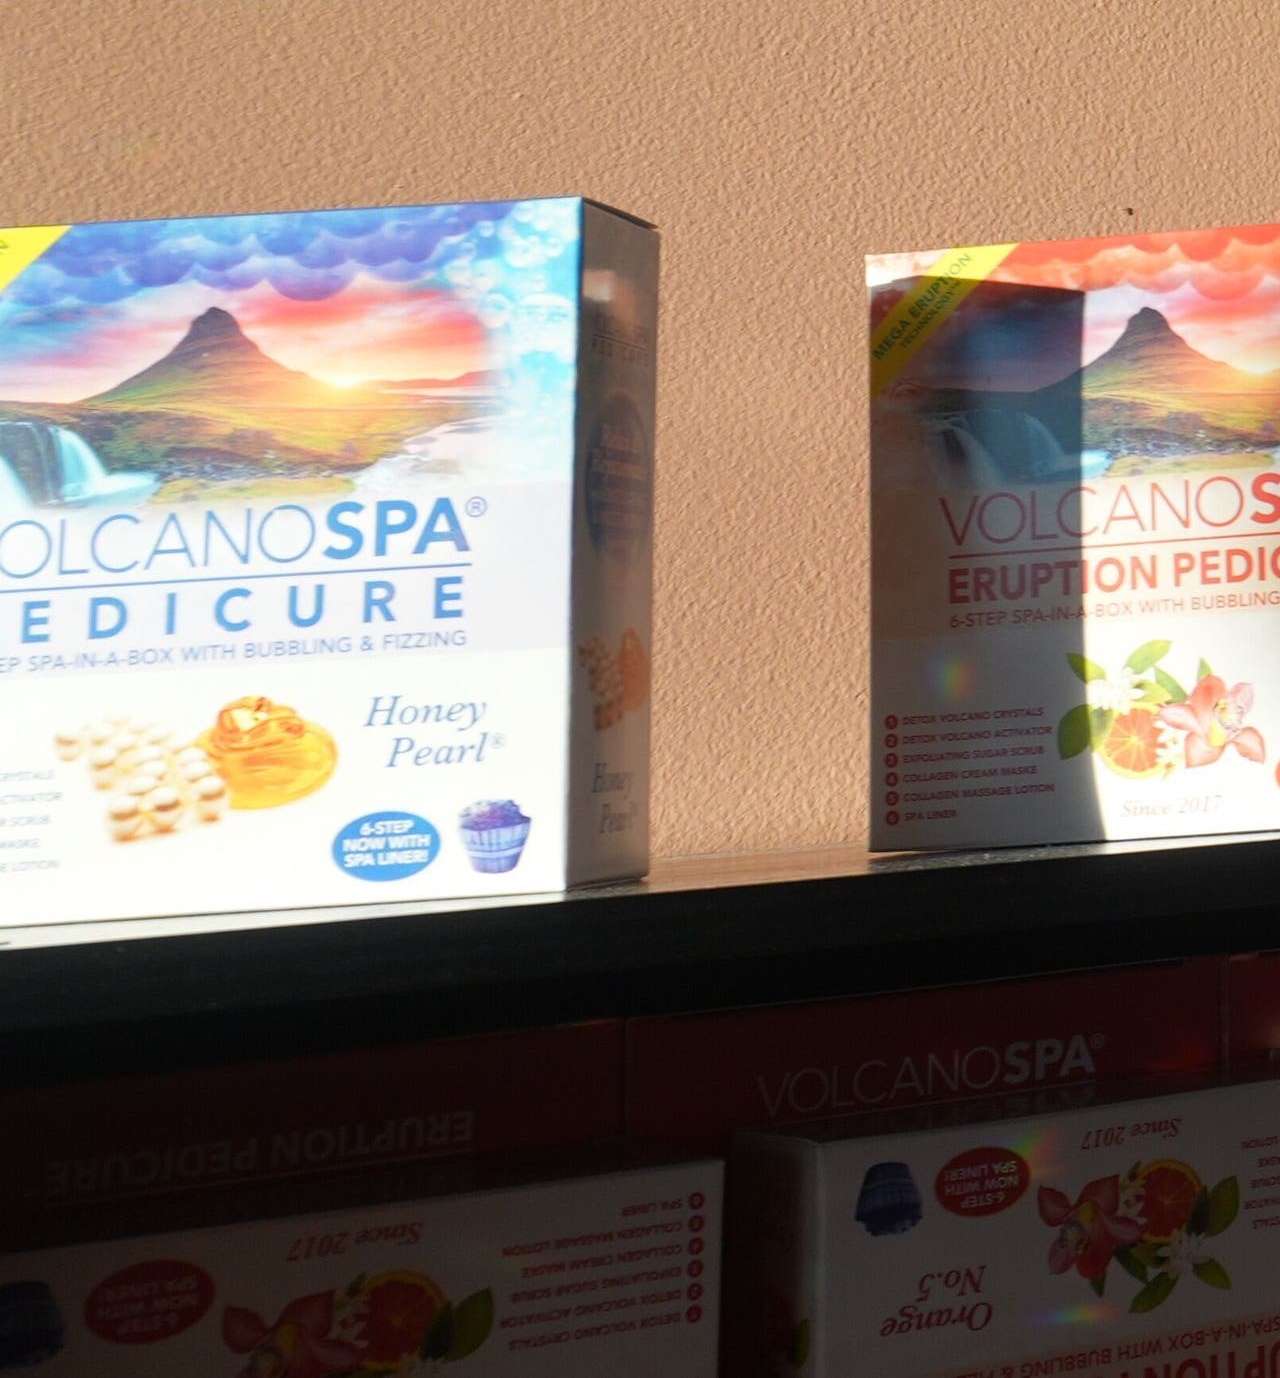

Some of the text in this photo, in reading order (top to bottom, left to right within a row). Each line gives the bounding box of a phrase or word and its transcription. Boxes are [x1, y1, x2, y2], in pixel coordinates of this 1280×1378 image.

[949, 554, 1158, 604] ERUPTION
[18, 574, 464, 645] EDICURE
[949, 610, 1006, 630] 6-STEP
[1012, 601, 1132, 625] SPA-IN-A-BOX
[1139, 598, 1183, 615] WITH
[1190, 590, 1280, 612] BUBBLING
[28, 629, 468, 675] SPA-IN-A-BOX WITH BUBBLING & FIZZING
[365, 694, 487, 728] Honey
[1118, 792, 1224, 819] Since 2017
[342, 832, 431, 852] NOW WITH
[359, 817, 414, 835] 6-STEP
[343, 848, 431, 868] SPA LINER!
[1079, 1116, 1181, 1151] Since 2017
[46, 1110, 475, 1196] ERUPTION PEDICURE
[284, 1219, 424, 1263] Since 2017
[916, 1262, 987, 1303] No.5
[879, 1303, 993, 1338] Orange
